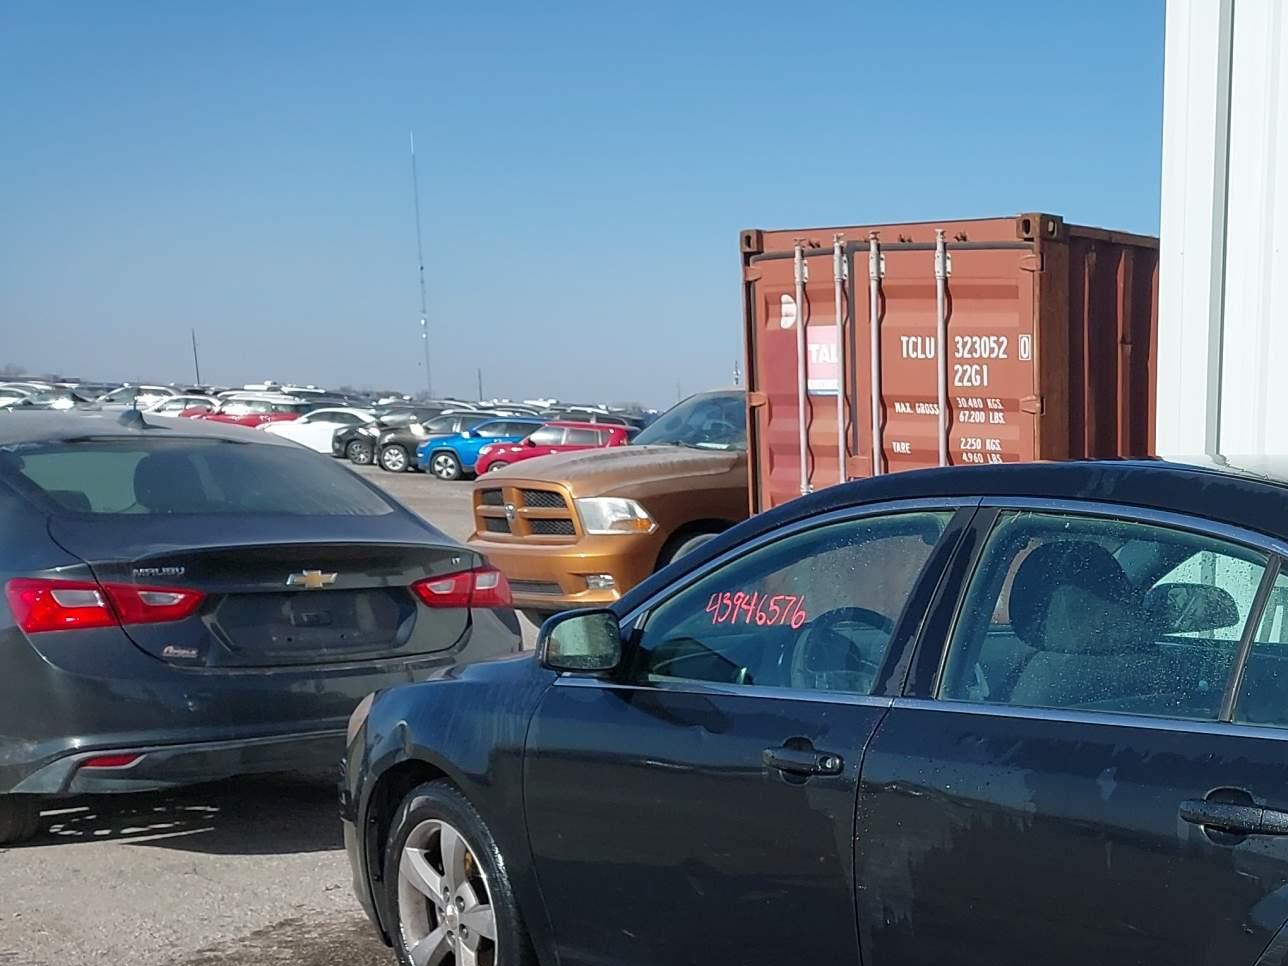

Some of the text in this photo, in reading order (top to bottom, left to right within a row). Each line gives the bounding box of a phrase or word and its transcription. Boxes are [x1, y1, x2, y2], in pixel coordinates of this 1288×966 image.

[901, 335, 1030, 360] TCLU 323052 0
[954, 364, 988, 386] 22G1
[916, 403, 940, 415] GROSS
[892, 442, 911, 454] TARE
[705, 591, 806, 629] 43946576
